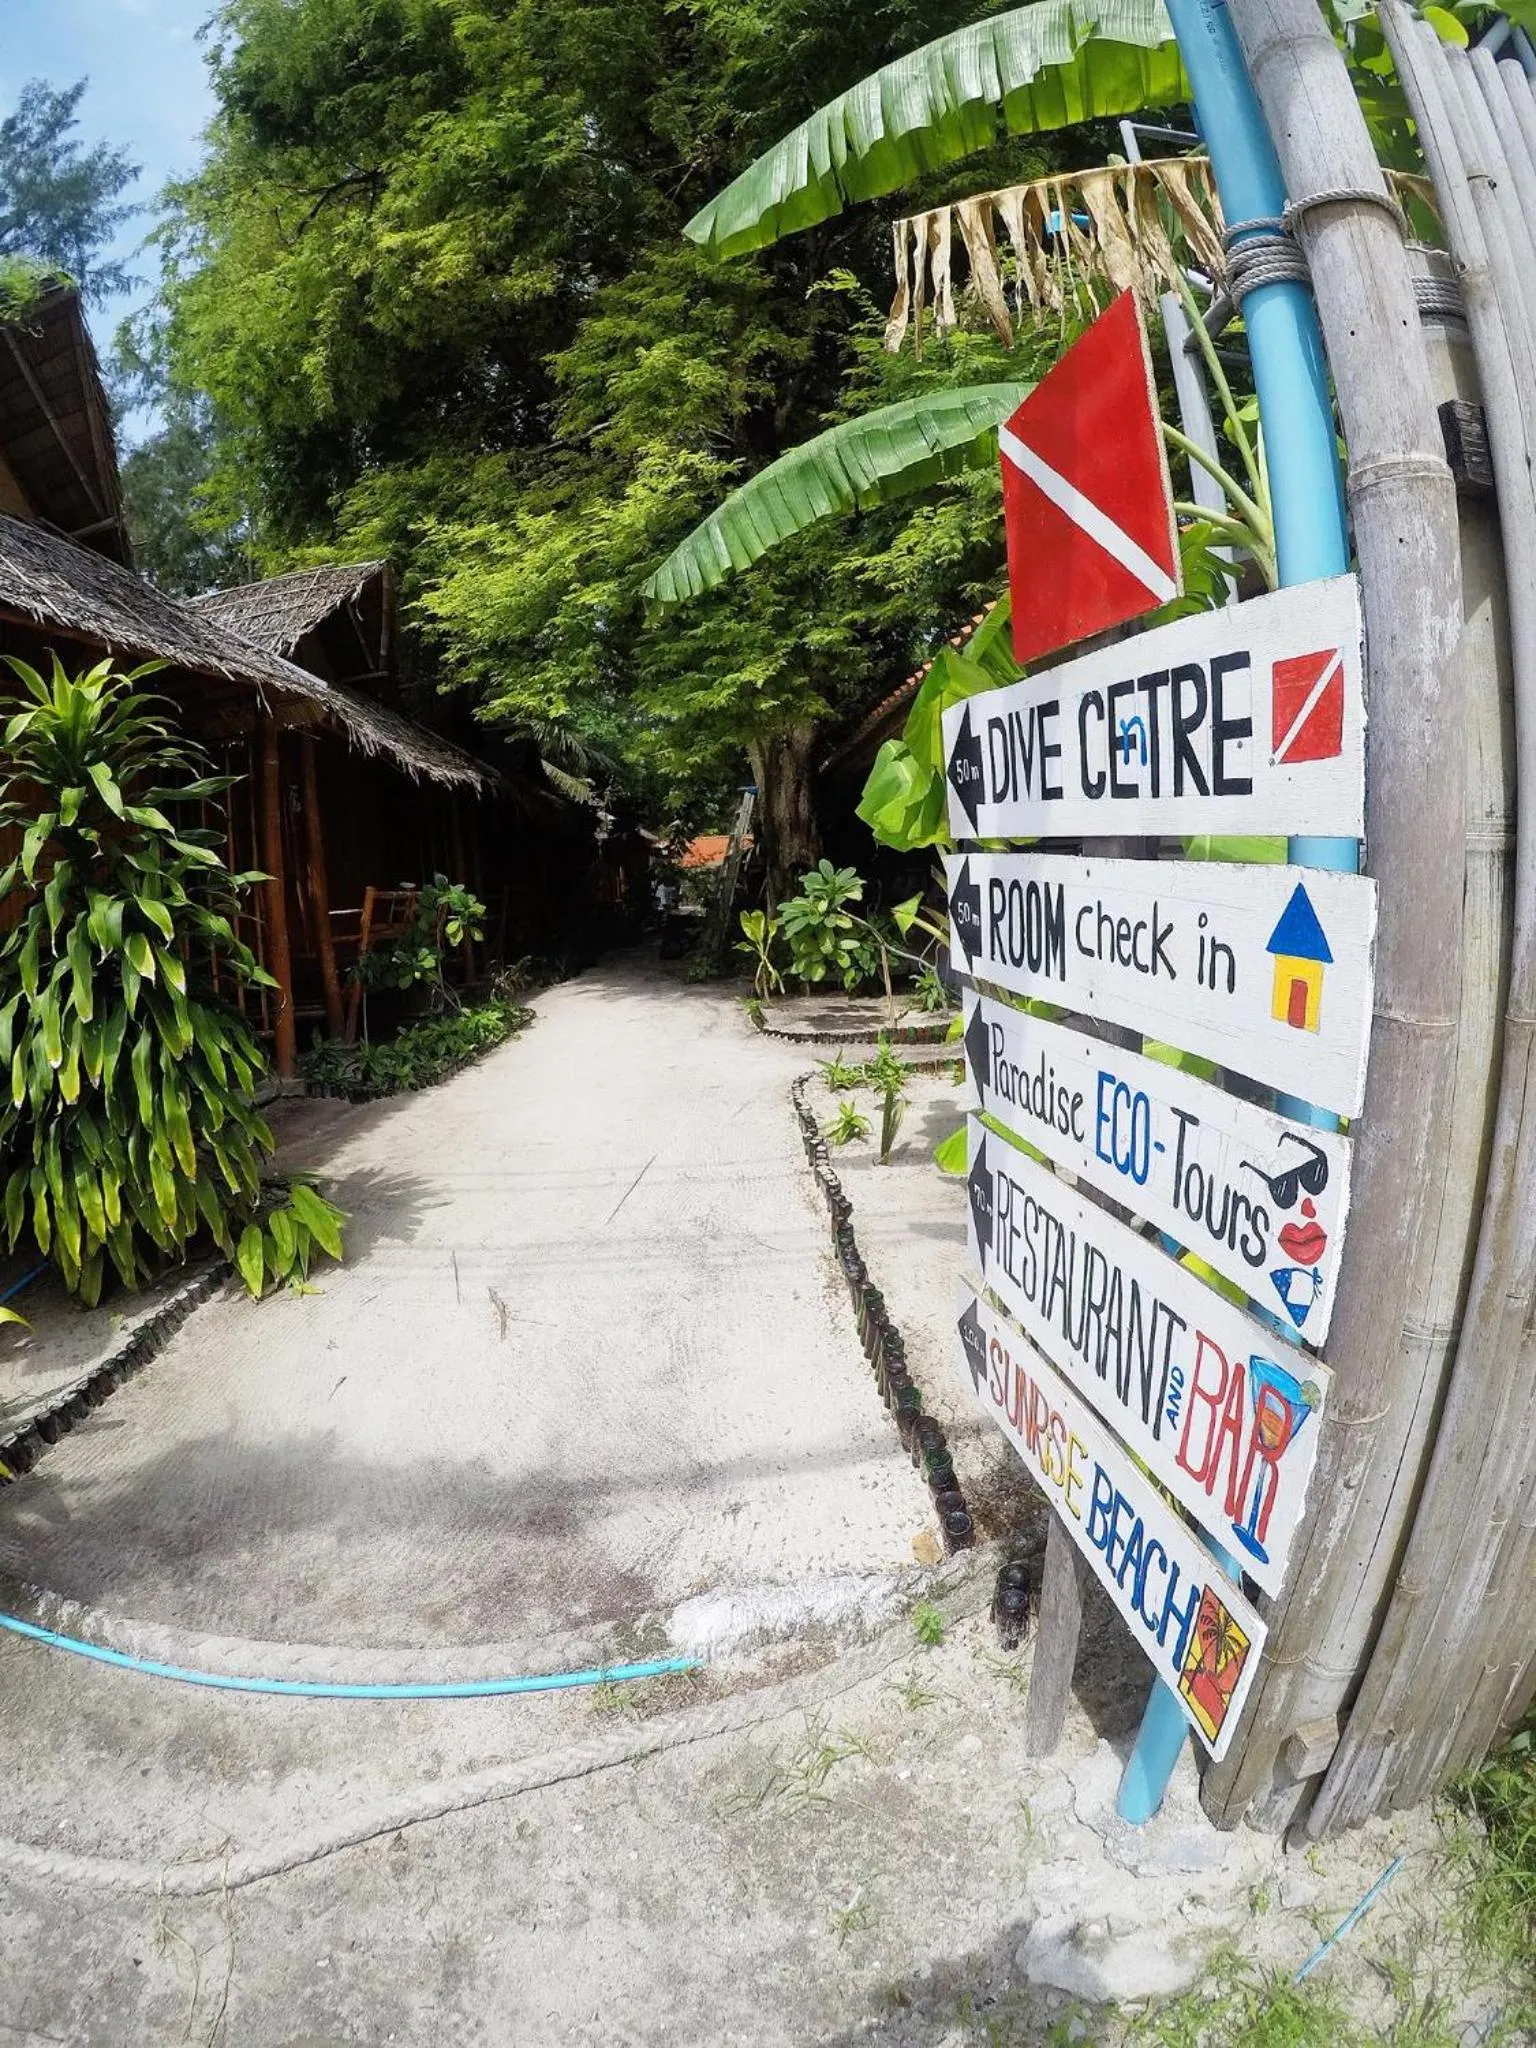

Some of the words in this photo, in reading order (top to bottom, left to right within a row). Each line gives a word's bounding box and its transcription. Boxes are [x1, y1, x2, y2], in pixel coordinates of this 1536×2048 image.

[987, 700, 1063, 804] DIVE
[989, 877, 1066, 982] ROOM
[1075, 900, 1177, 980] check
[1197, 912, 1235, 994] in
[991, 1022, 1085, 1143] Paradise
[997, 1170, 1187, 1441] RESTAURANT
[1164, 1366, 1186, 1431] AND
[1174, 1329, 1292, 1544] BAR
[1085, 1461, 1201, 1672] BEACH
